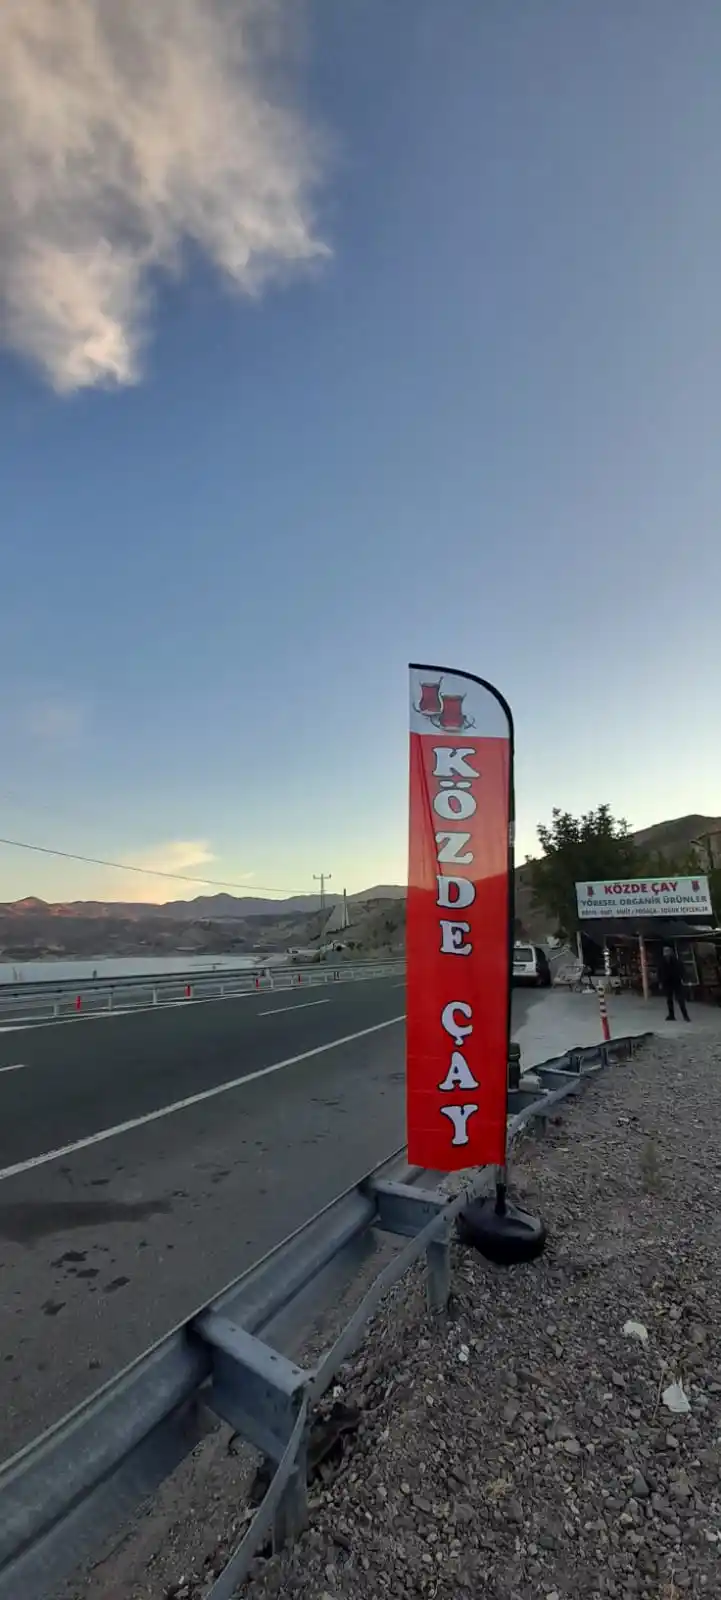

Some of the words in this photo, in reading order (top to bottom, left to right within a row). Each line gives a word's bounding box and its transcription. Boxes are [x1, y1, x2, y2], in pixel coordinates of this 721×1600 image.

[432, 747, 480, 955] KÖZDE
[604, 882, 648, 894] KÖZDE
[651, 881, 678, 895] ÇAY
[580, 897, 618, 906] YÖRESEL
[620, 896, 660, 905] ORGANİK
[663, 895, 707, 904] ÜRÜNLER
[438, 1000, 479, 1146] ÇAY
